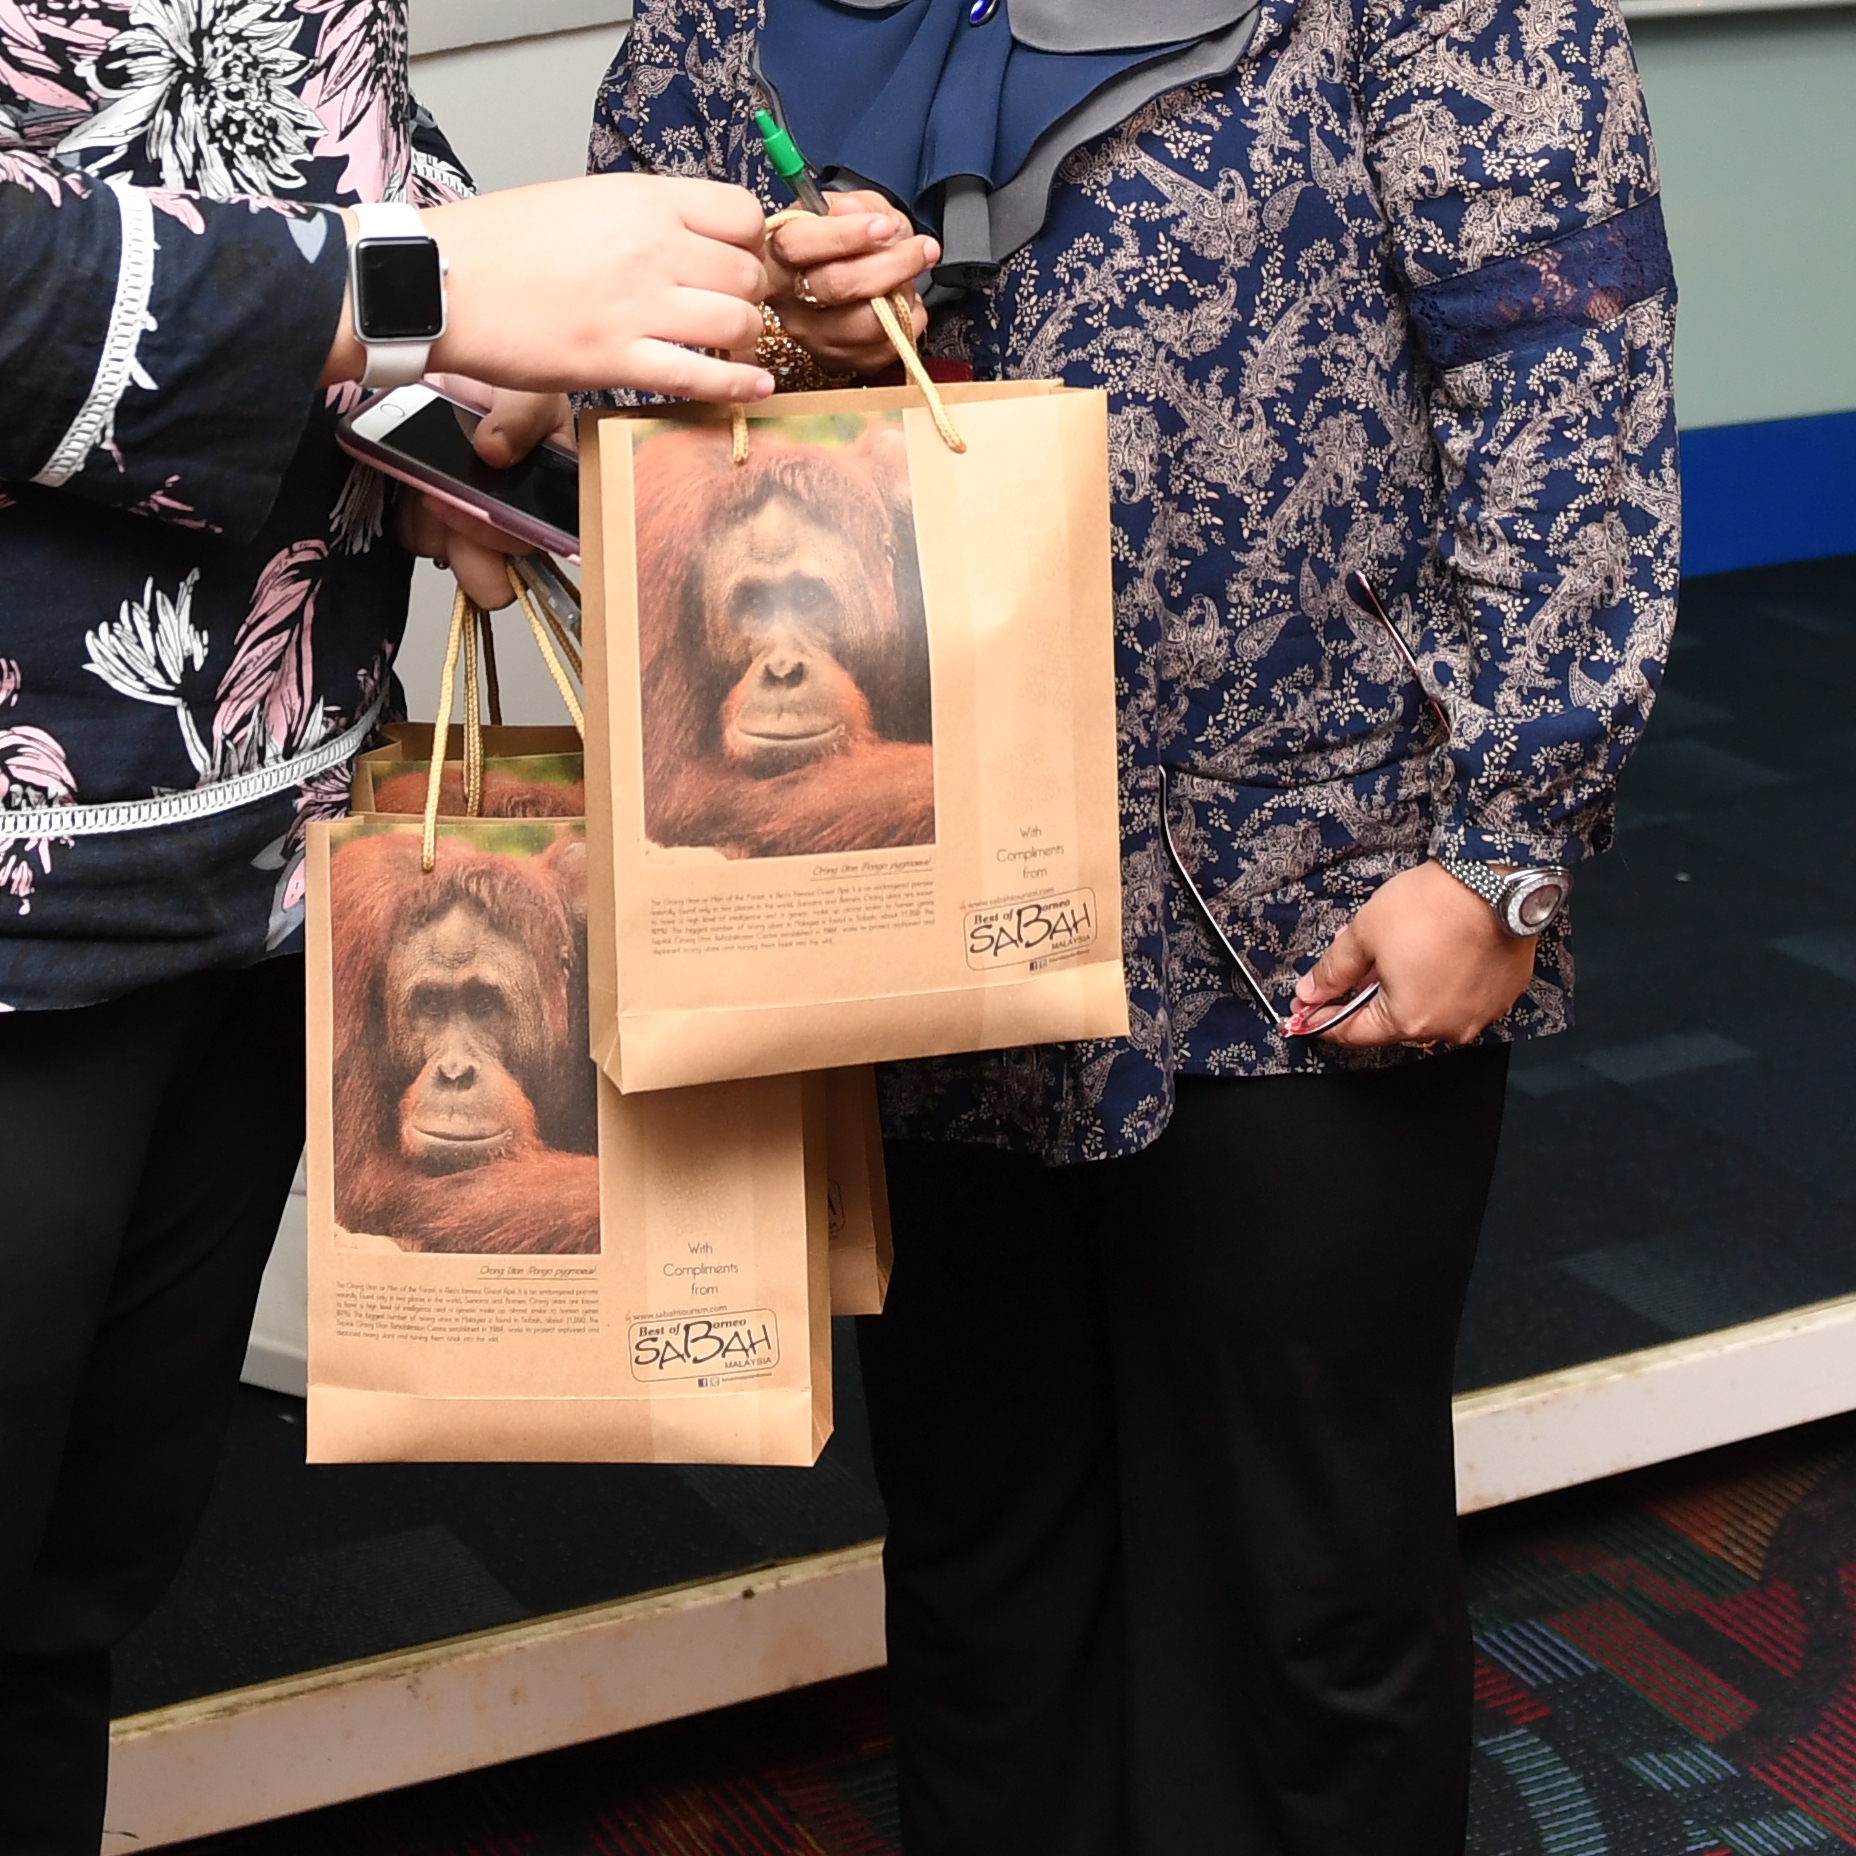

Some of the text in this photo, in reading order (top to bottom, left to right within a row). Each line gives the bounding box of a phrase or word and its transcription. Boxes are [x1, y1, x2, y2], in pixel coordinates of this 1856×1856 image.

[1020, 826, 1042, 838] With
[996, 844, 1064, 863] Compliments
[1023, 867, 1048, 879] from
[974, 913, 998, 925] Best
[1003, 908, 1014, 921] of
[970, 902, 1091, 957] SABAH
[1051, 934, 1091, 950] MALAYSIA
[687, 1242, 713, 1255] With
[663, 1262, 739, 1279] Compliments
[691, 1283, 719, 1296] from
[633, 1304, 727, 1321] www.sabahtourism.com
[639, 1326, 665, 1338] Best
[668, 1322, 682, 1336] of
[634, 1320, 772, 1370] SABAH
[724, 1356, 772, 1369] MALAYSIA
